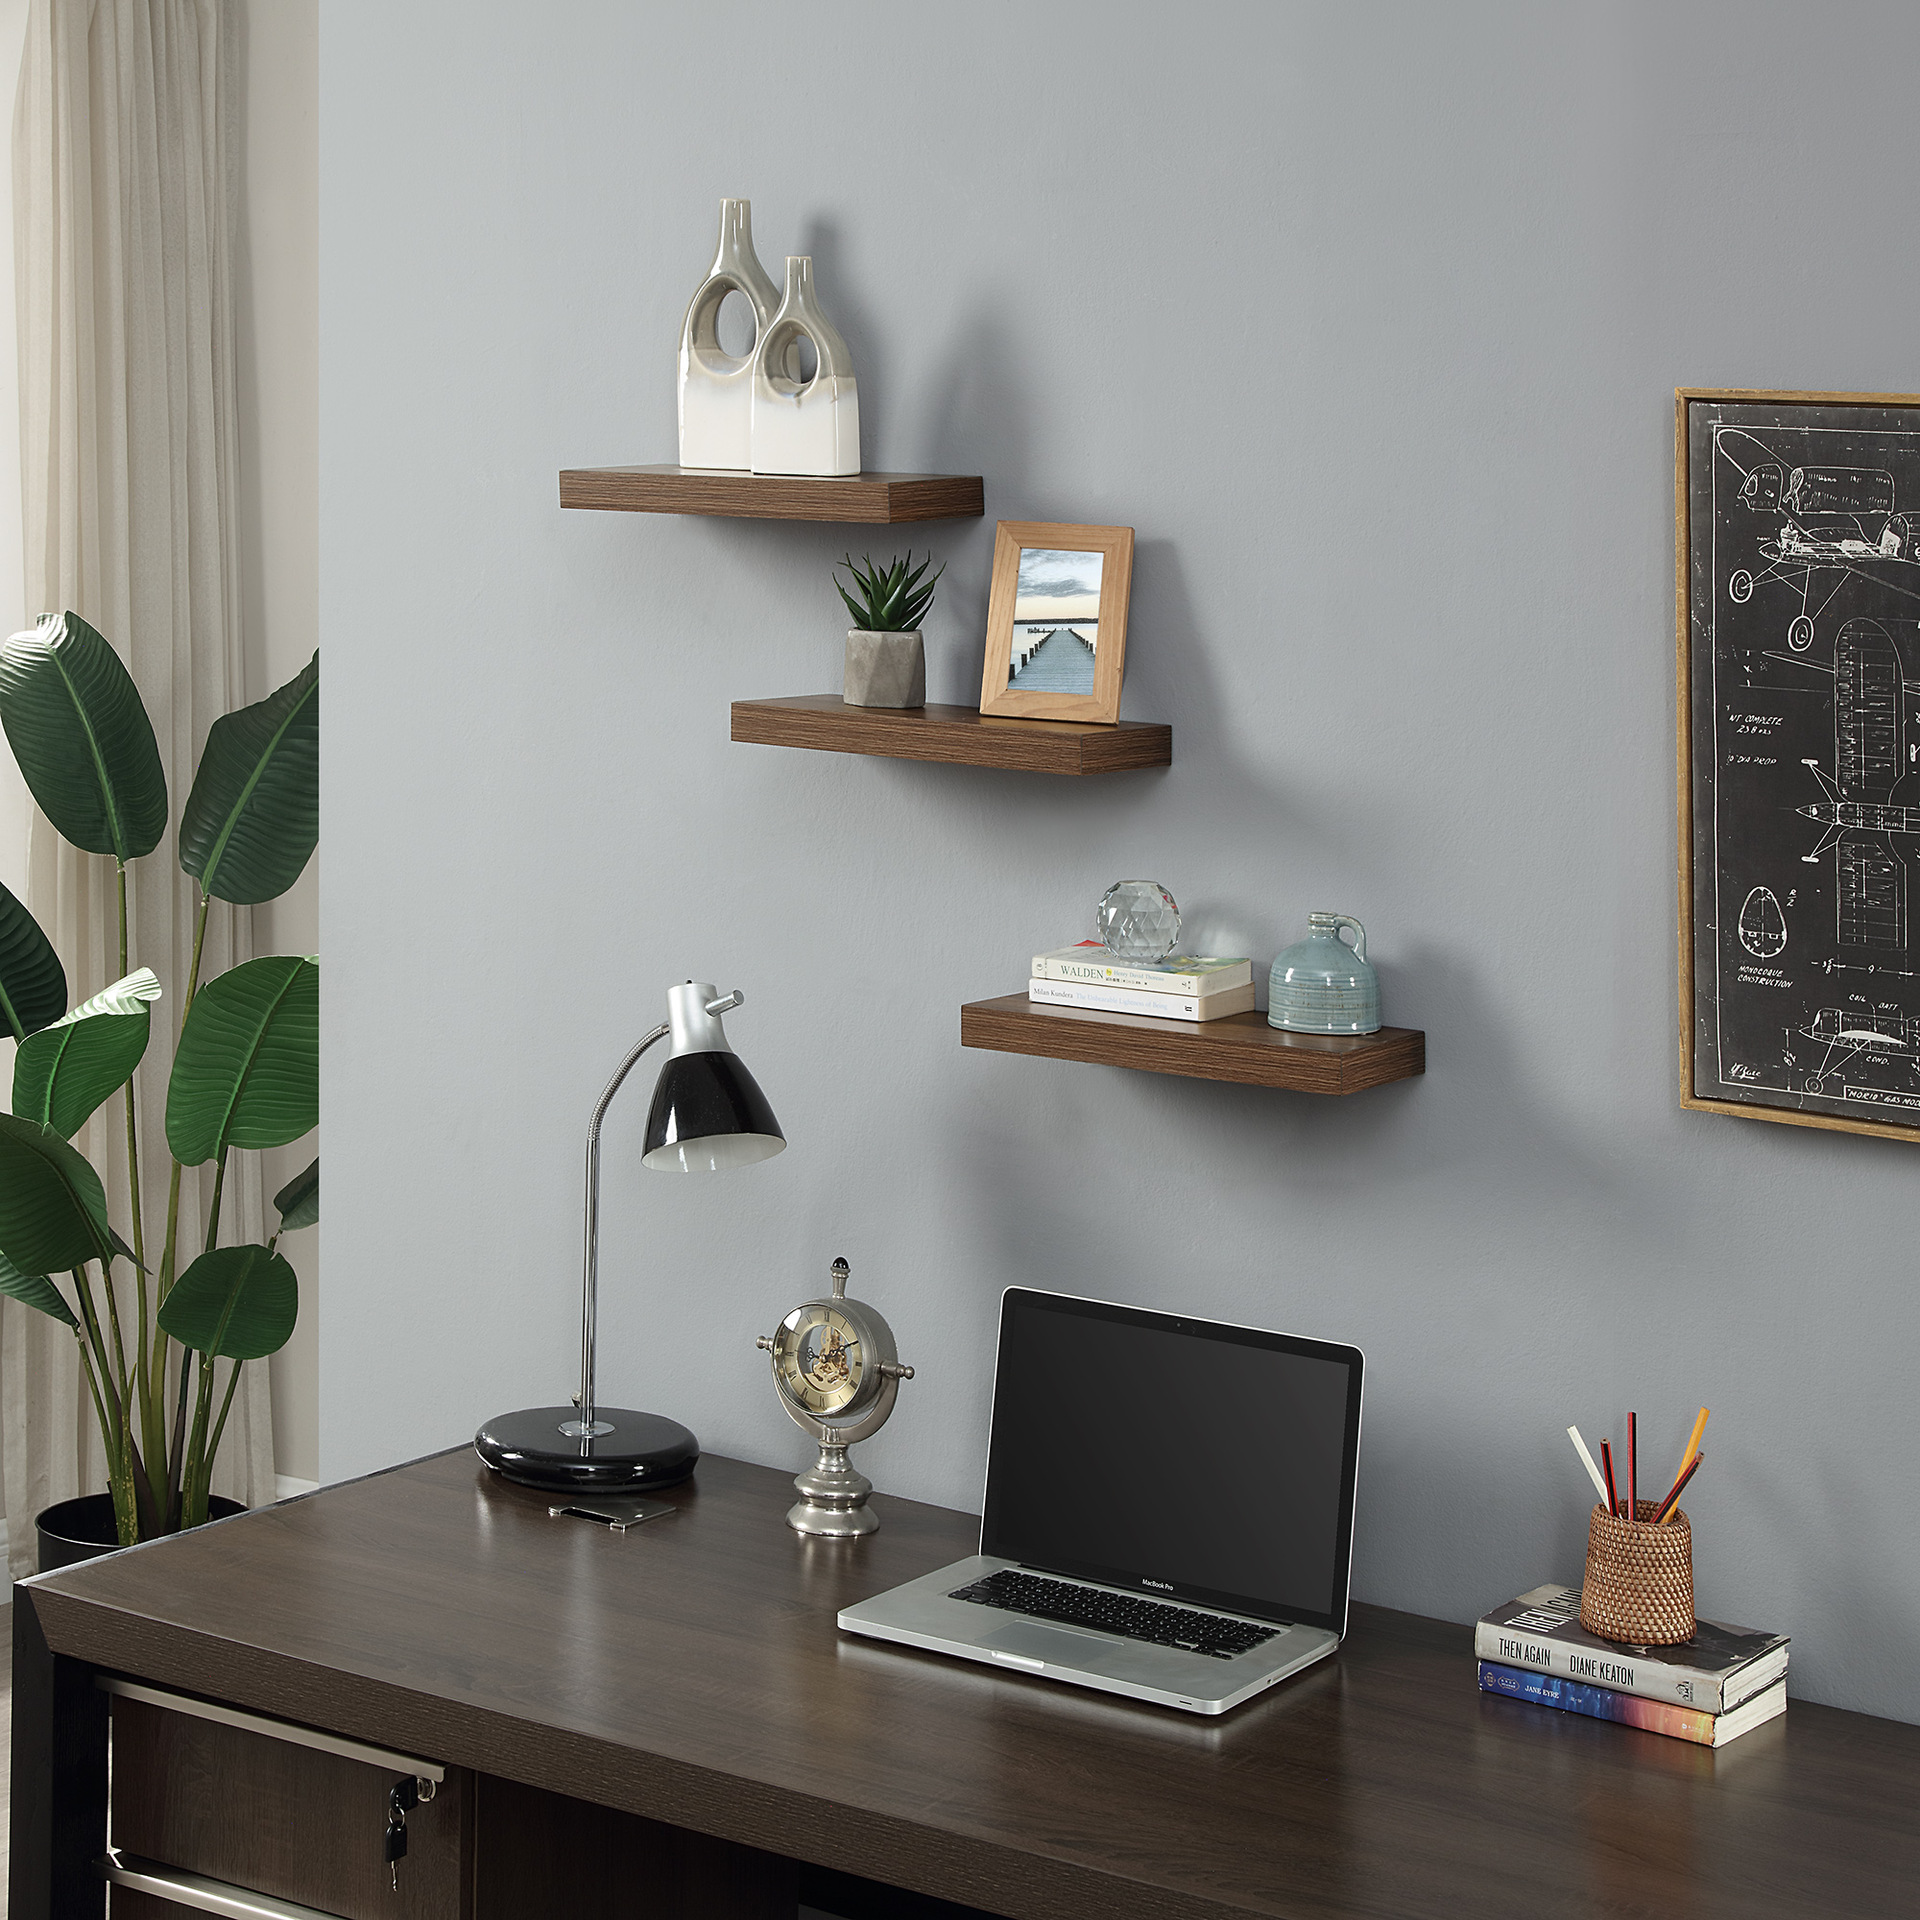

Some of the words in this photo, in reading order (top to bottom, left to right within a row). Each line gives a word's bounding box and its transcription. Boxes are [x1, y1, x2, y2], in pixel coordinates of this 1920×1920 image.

[1060, 964, 1104, 979] WALDEN
[1738, 965, 1784, 977] MONOCOQUE
[1737, 973, 1793, 988] CONSTRUCTION
[1033, 988, 1050, 996] Milan
[1050, 989, 1073, 998] Kundera
[1848, 993, 1867, 1002] COIL
[1142, 1578, 1165, 1589] MacBook
[1164, 1583, 1174, 1591] Pro
[1503, 1608, 1574, 1633] THEN
[1498, 1637, 1522, 1660] THEN
[1524, 1644, 1551, 1667] AGAIN
[1569, 1654, 1597, 1678] DIANE
[1599, 1661, 1634, 1687] KEATON
[1524, 1685, 1542, 1695] JANE
[1542, 1688, 1560, 1699] EYRE
